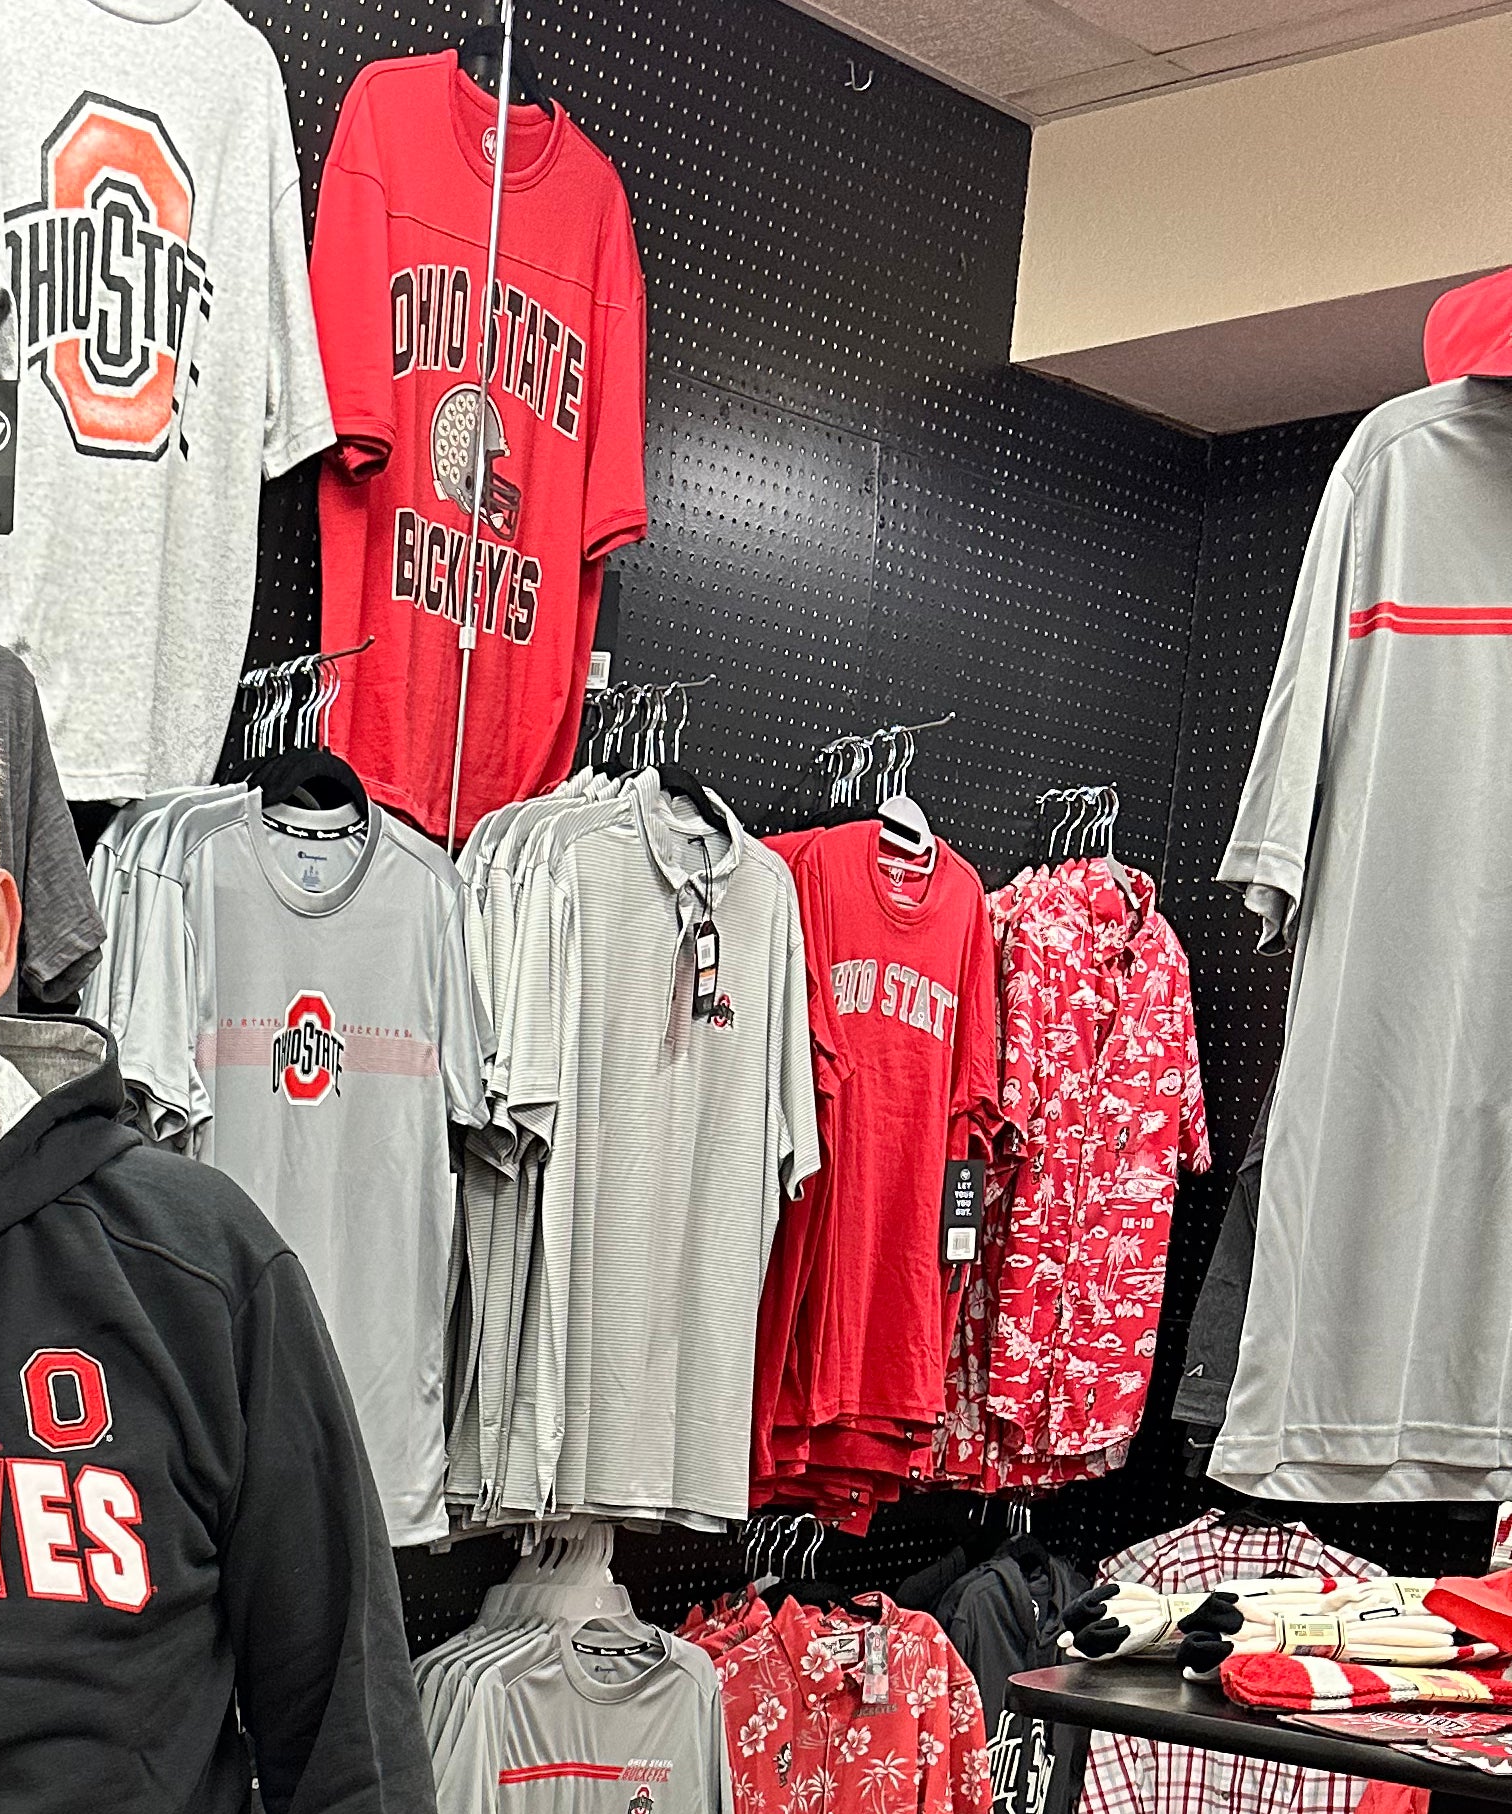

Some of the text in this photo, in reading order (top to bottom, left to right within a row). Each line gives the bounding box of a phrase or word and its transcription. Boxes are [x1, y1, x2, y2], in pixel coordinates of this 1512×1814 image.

[390, 264, 586, 441] OHIO STATE
[881, 962, 959, 1049] STAT
[20, 1348, 113, 1453] O
